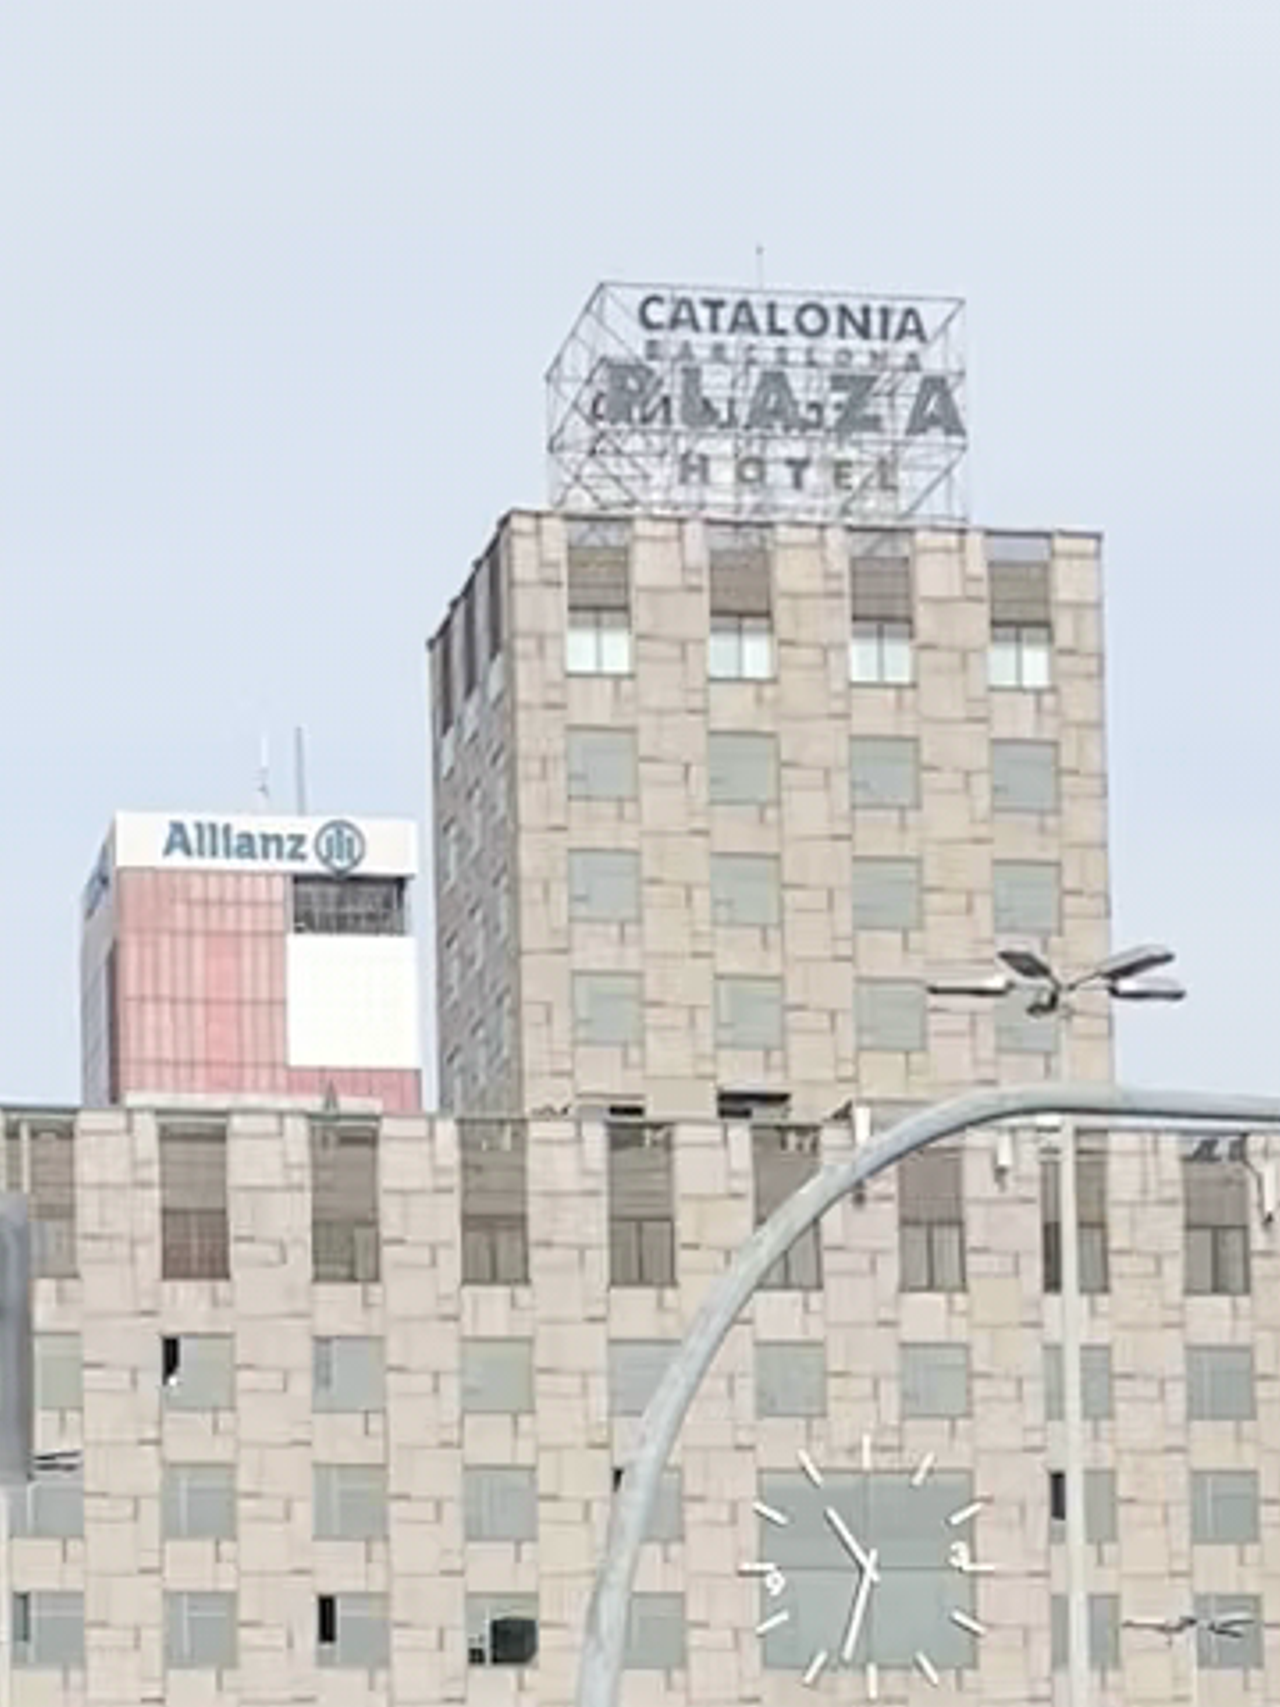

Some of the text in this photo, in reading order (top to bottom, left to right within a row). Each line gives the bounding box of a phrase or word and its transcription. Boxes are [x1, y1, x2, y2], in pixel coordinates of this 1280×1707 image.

[637, 294, 928, 343] CATALONIA
[604, 362, 967, 437] PLAZA
[678, 451, 900, 492] HOTEL
[163, 820, 308, 861] Allianz
